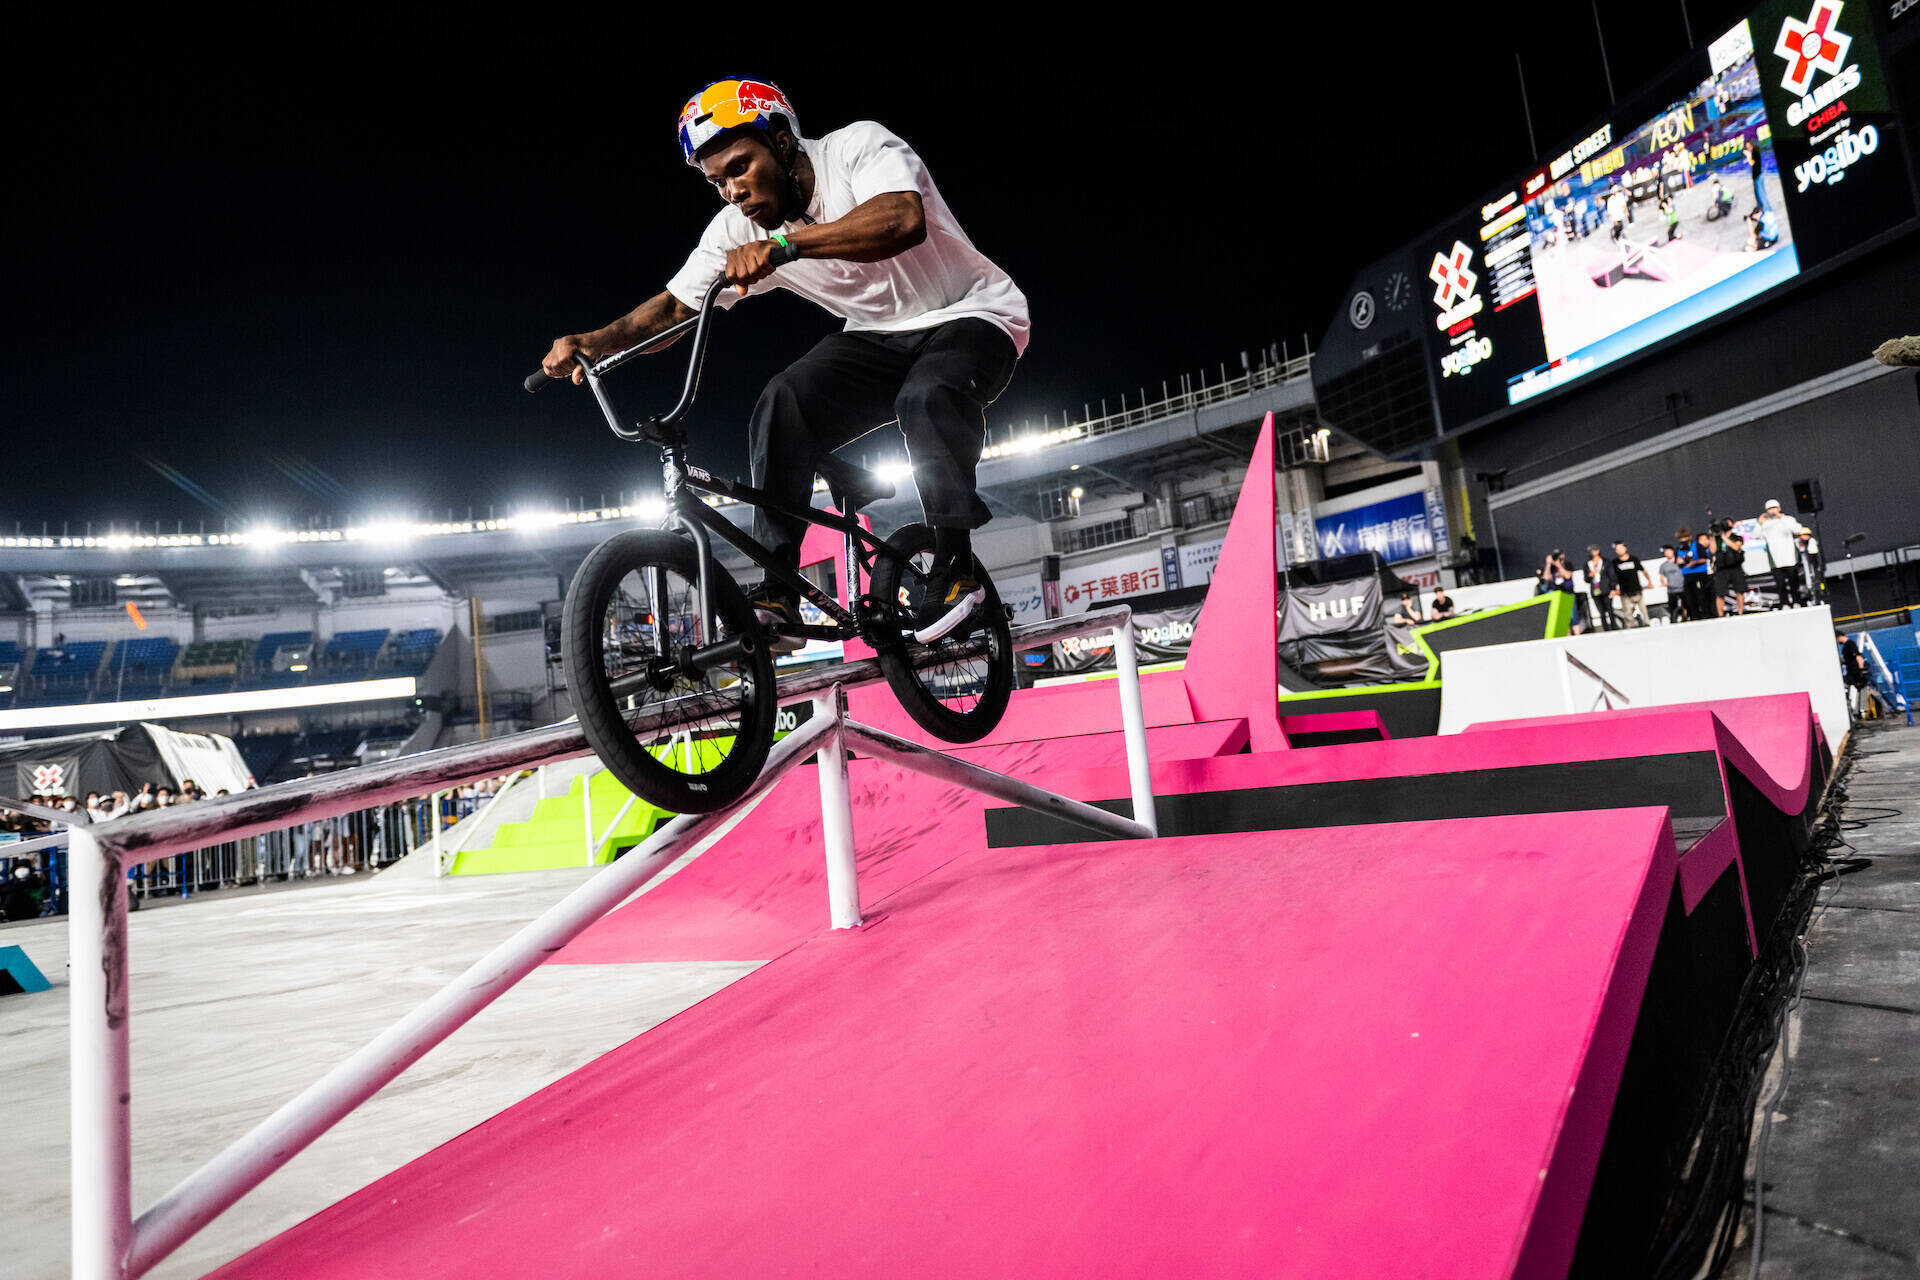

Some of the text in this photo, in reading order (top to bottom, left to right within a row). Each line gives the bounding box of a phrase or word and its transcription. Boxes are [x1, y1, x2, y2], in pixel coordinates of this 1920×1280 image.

[1786, 64, 1862, 127] GAMES
[1807, 100, 1848, 132] CHIBA
[1794, 124, 1879, 193] yogibo
[685, 463, 711, 482] VANS
[1081, 566, 1161, 601] 千葉銀行
[1309, 595, 1366, 622] HUF
[1141, 620, 1194, 647] yogibo
